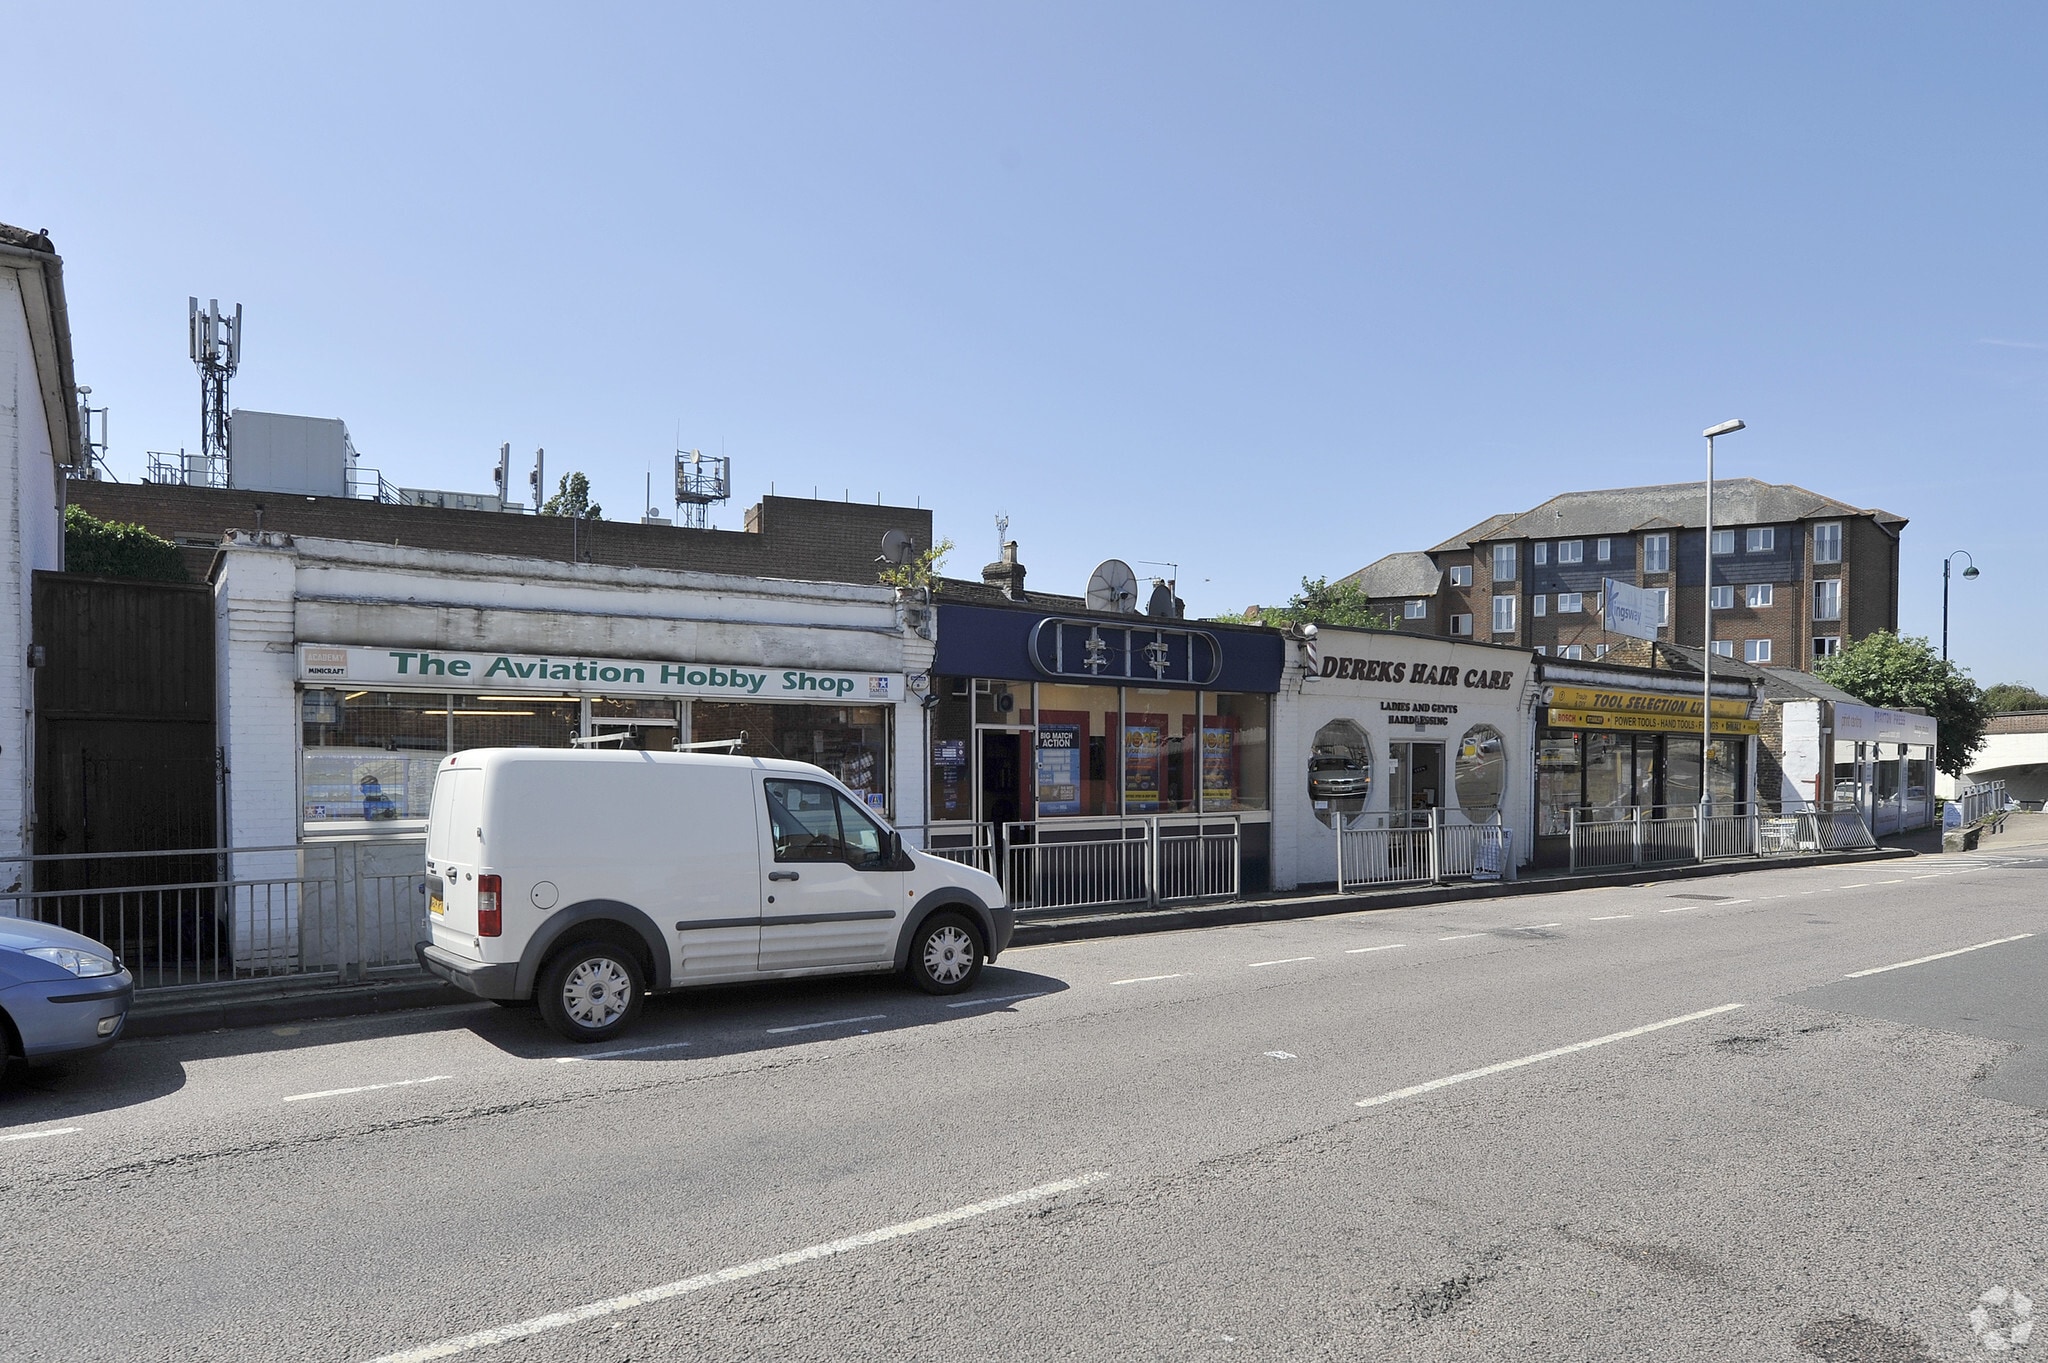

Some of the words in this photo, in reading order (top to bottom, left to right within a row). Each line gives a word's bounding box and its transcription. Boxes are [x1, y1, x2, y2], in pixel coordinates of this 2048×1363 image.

[308, 653, 345, 661] ACADEMY
[308, 667, 345, 675] MINICRAFT
[389, 651, 472, 677] The
[484, 656, 645, 684] Aviation
[660, 664, 767, 694] Hobby
[781, 671, 855, 697] Shop
[1320, 656, 1406, 684] DEREKS
[1410, 663, 1460, 687] HAIR
[1463, 669, 1514, 691] CARE
[1380, 701, 1410, 712] LADIES
[1412, 703, 1430, 713] AND
[1431, 704, 1458, 714] GENTS
[1593, 693, 1623, 709] TOOL
[1625, 696, 1687, 713] SELECTION
[1388, 715, 1449, 726] HAIRDRESSING
[1557, 713, 1577, 723] BOSCH
[1614, 716, 1637, 727] POWER
[1637, 717, 1657, 728] TOOLS
[1660, 719, 1677, 729] HAND
[1677, 720, 1695, 730] TOOLS
[1040, 732, 1051, 740] BIG
[1052, 732, 1073, 740] MATCH
[1042, 739, 1070, 748] ACTION
